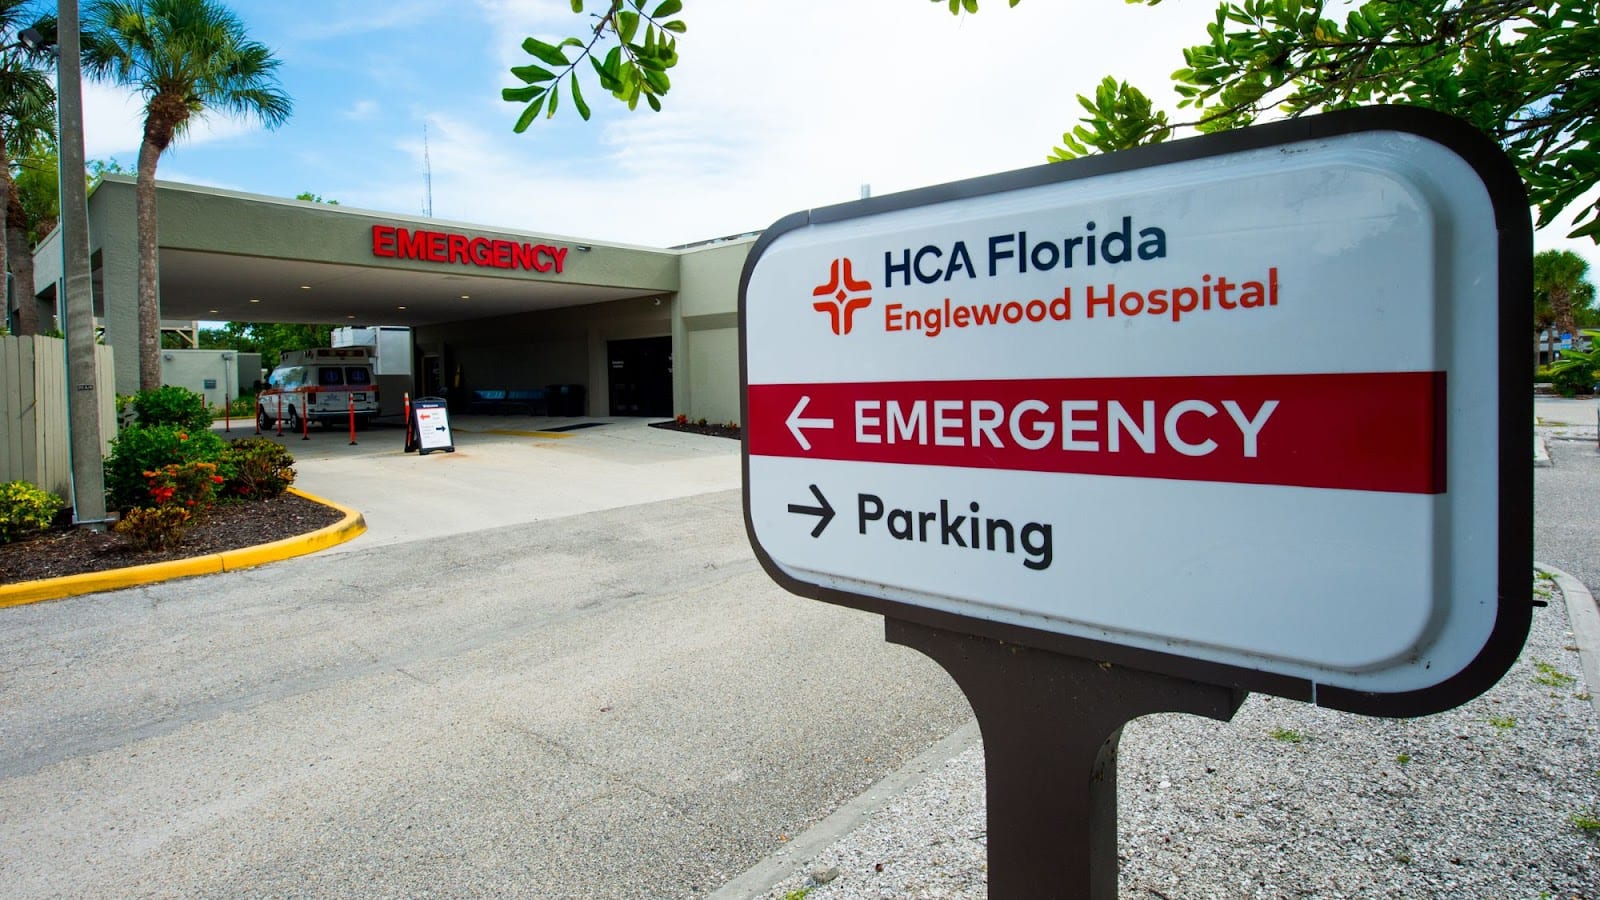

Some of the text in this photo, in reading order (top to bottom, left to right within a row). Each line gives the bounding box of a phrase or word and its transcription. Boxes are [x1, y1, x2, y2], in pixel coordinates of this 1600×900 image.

[372, 225, 568, 274] EMERGENCY
[885, 216, 1167, 288] HCA Florida
[885, 267, 1279, 337] Englewood Hospital
[854, 399, 1280, 458] EMERGENCY
[857, 493, 1053, 570] Parking
